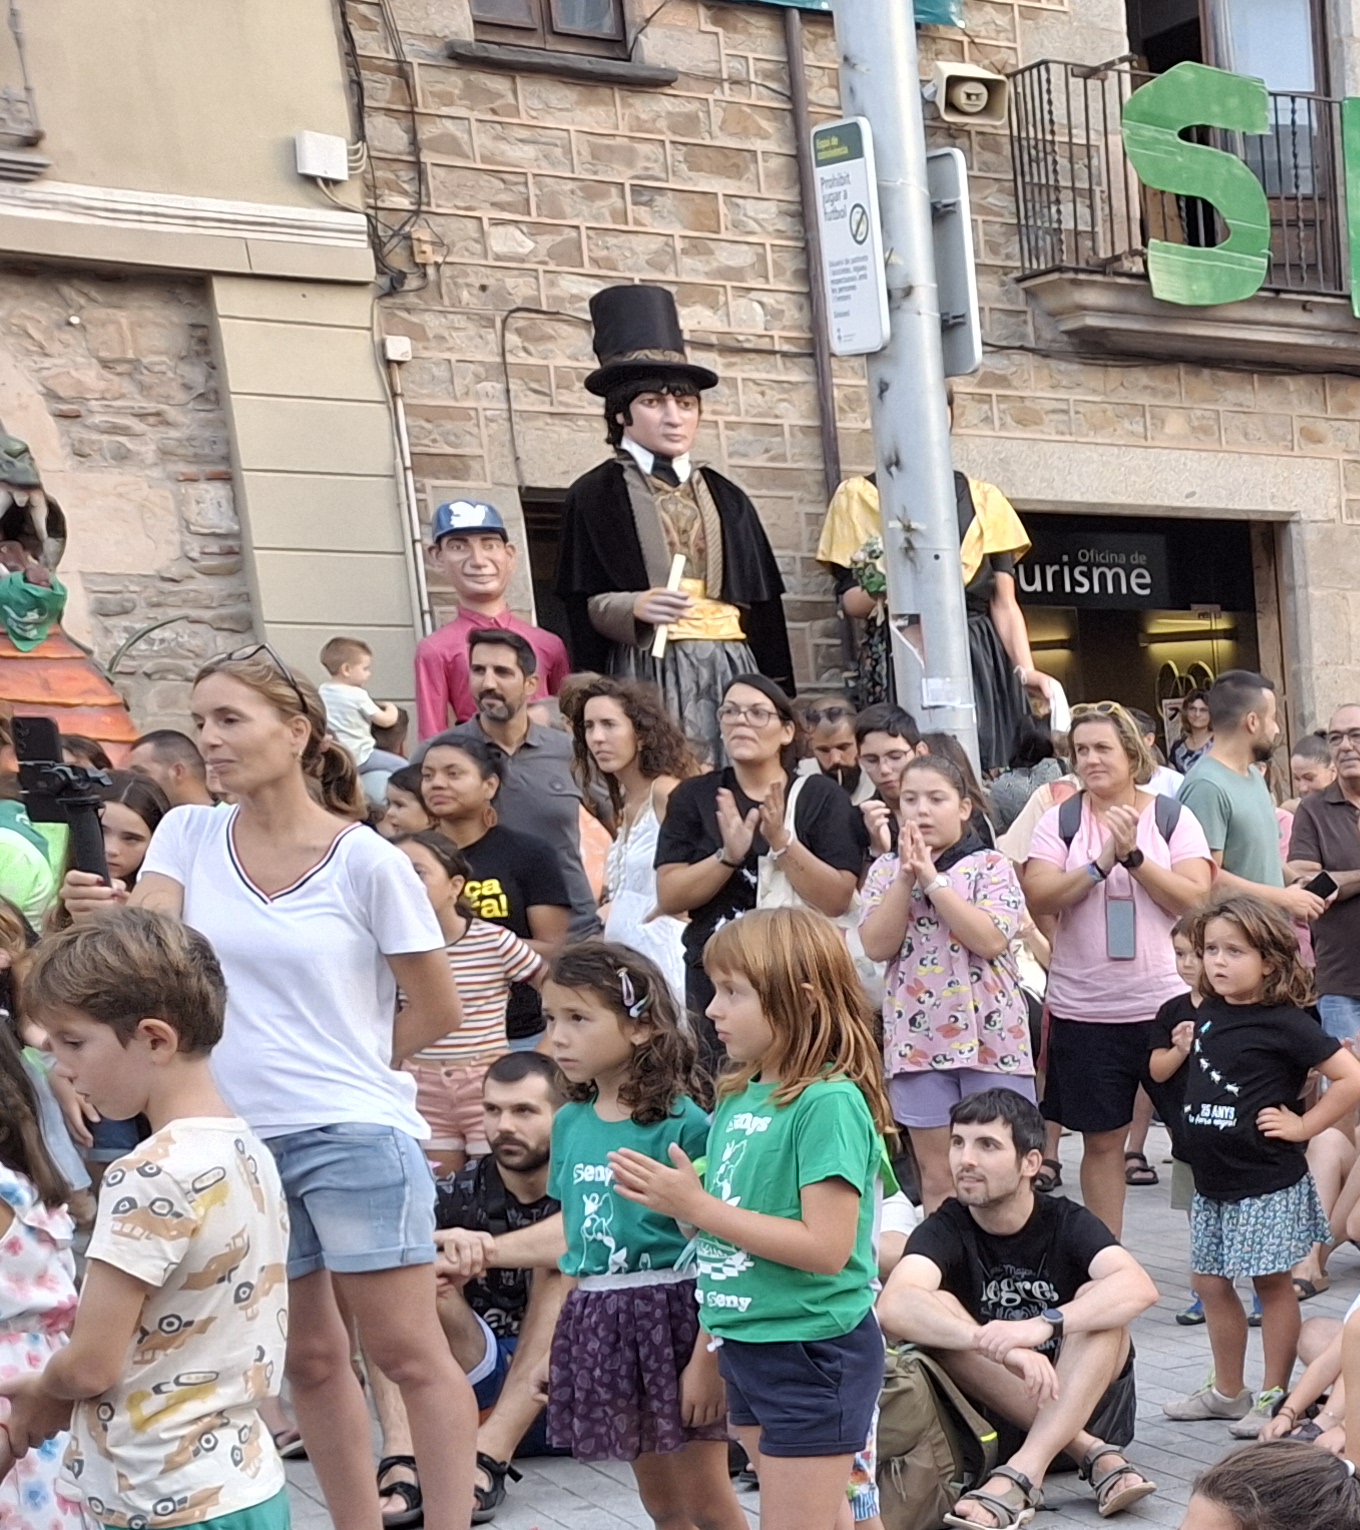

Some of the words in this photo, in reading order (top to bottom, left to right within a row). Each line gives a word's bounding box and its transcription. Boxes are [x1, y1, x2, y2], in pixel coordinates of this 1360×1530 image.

[820, 172, 851, 192] Prohibit
[1078, 549, 1126, 565] Oficina
[1129, 550, 1147, 565] de
[1014, 555, 1152, 596] urisme
[1200, 1103, 1212, 1118] 25
[1211, 1104, 1235, 1120] ANYS
[572, 1162, 614, 1187] Seny
